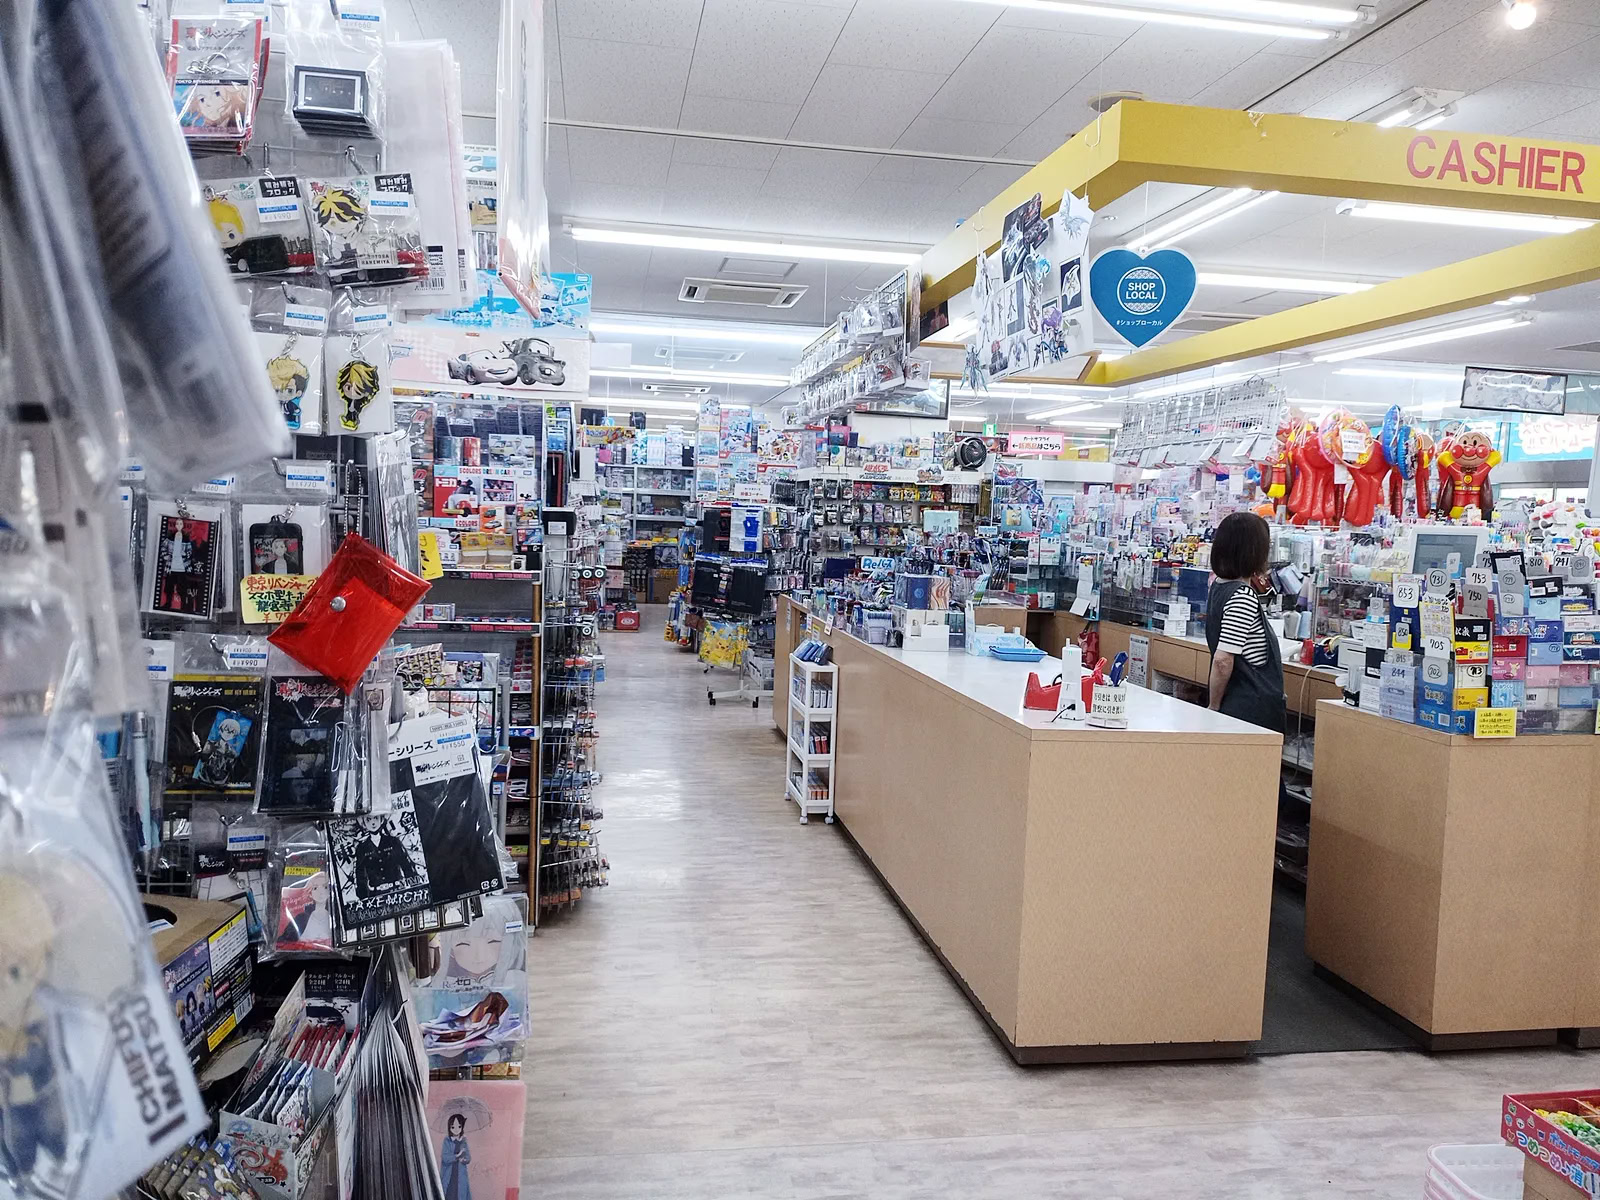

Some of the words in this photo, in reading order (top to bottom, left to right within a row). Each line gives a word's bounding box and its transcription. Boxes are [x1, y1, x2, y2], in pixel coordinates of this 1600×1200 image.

[1406, 135, 1586, 194] CASHIER
[1127, 282, 1156, 291] SHOP
[1125, 291, 1158, 300] LOCAL
[1529, 558, 1543, 567] 810
[1555, 557, 1569, 566] 941
[1471, 573, 1487, 584] 753
[1398, 587, 1414, 600] 853
[1467, 590, 1482, 601] 750
[263, 612, 292, 623] ¥77
[1429, 639, 1445, 651] 705
[347, 890, 429, 912] TAKEMICHI
